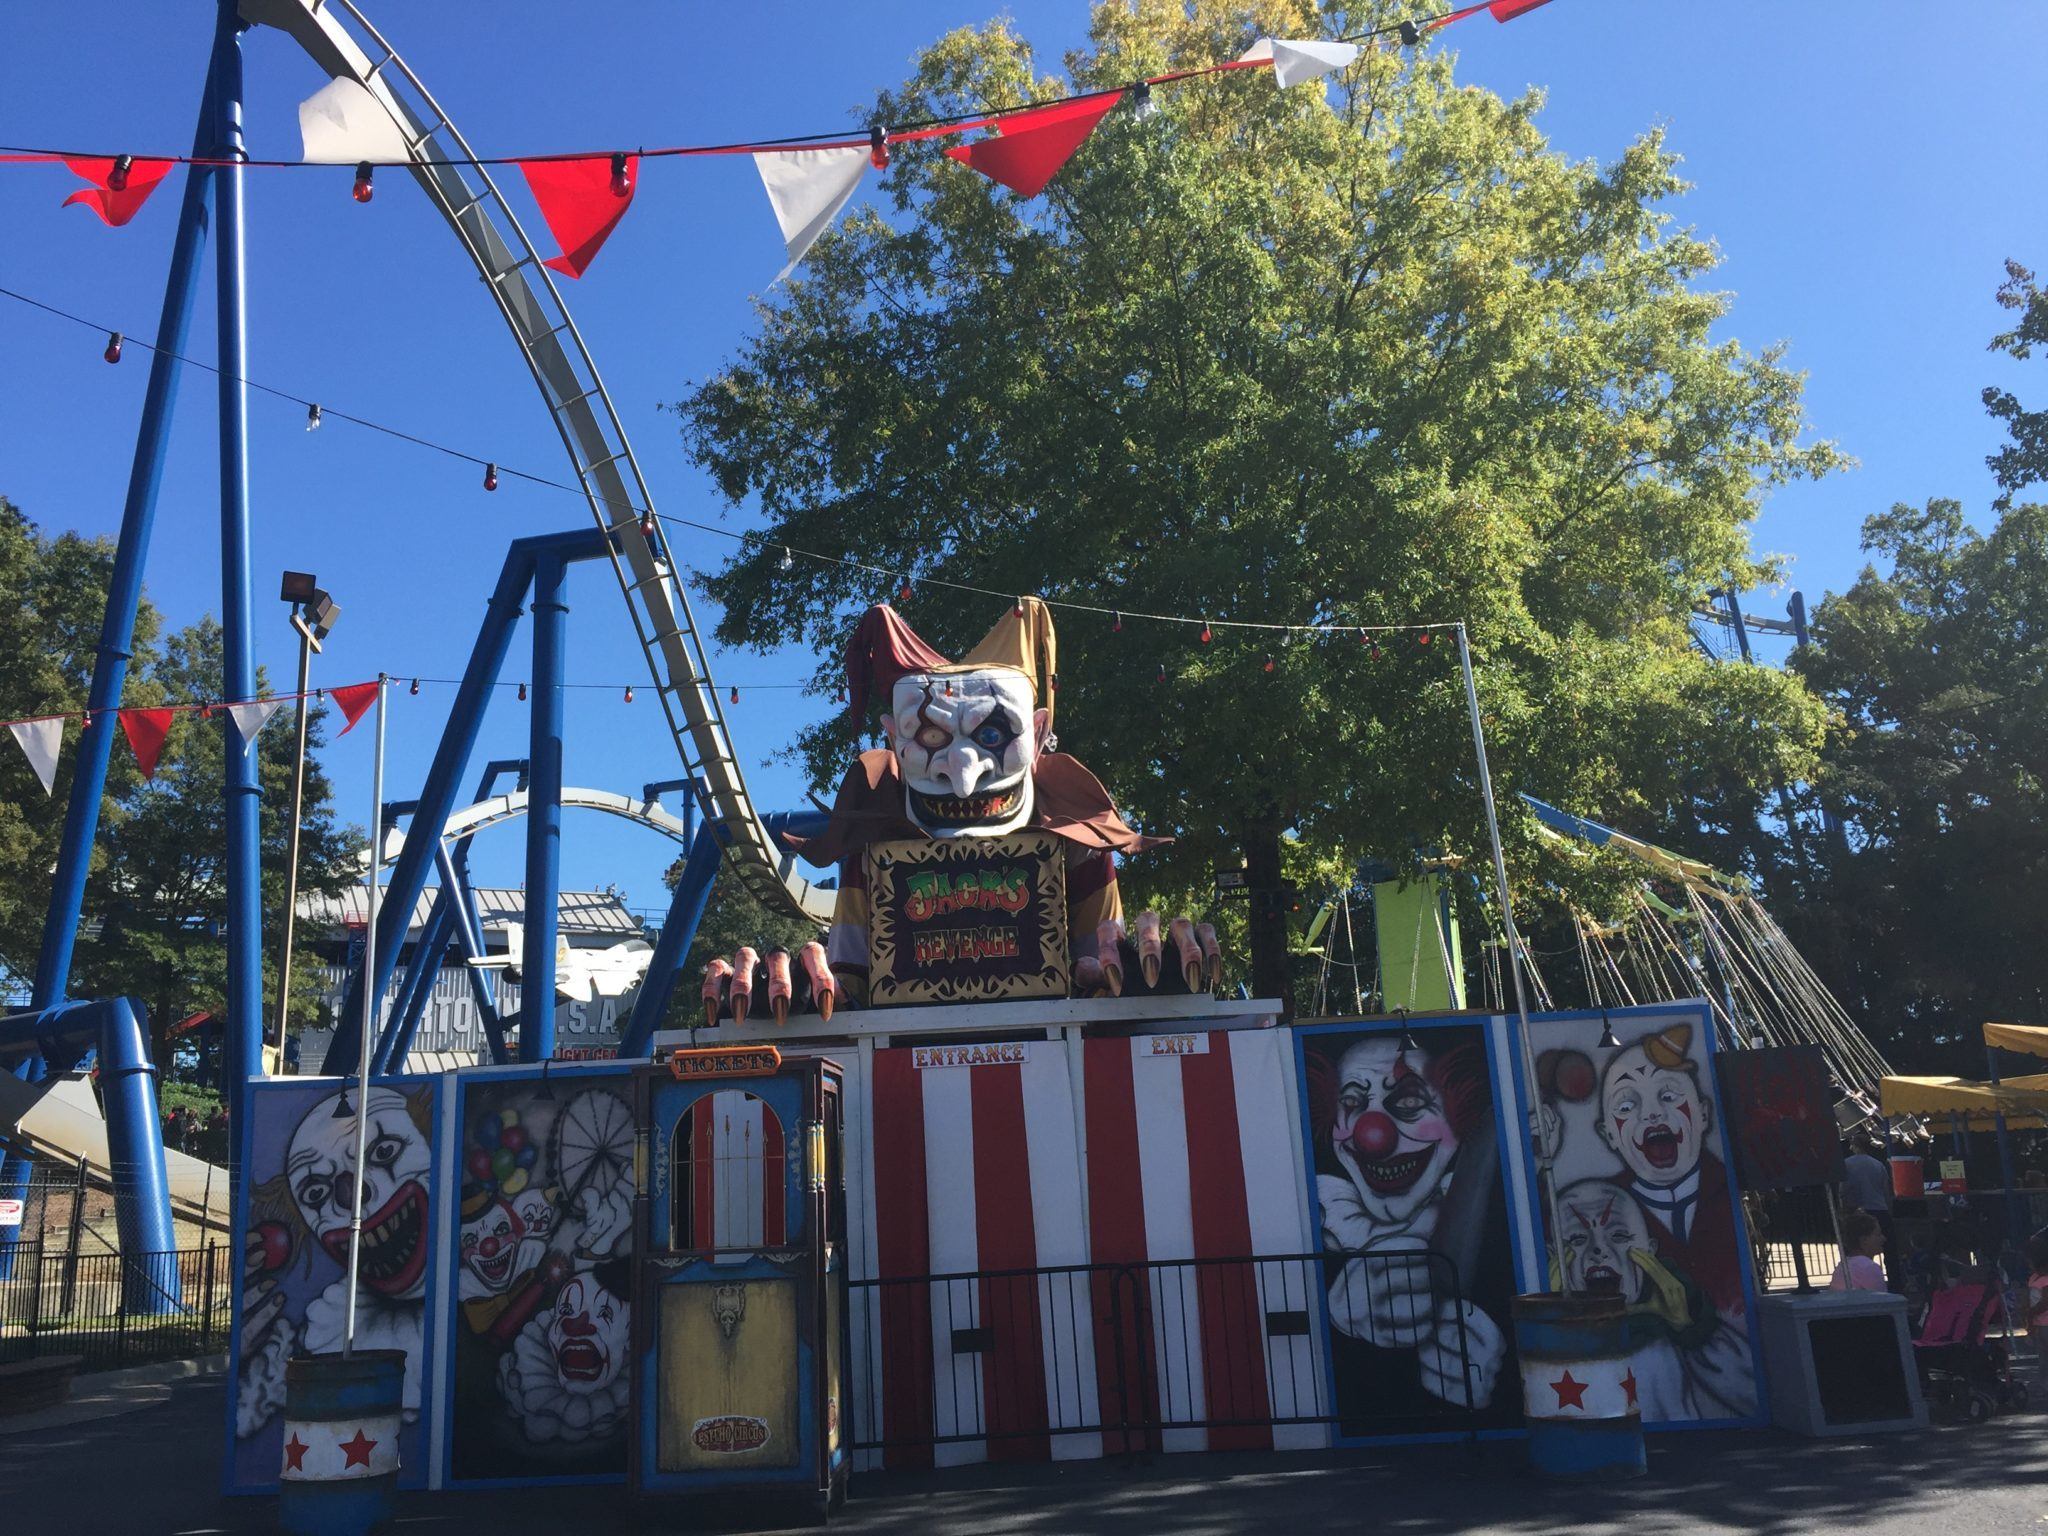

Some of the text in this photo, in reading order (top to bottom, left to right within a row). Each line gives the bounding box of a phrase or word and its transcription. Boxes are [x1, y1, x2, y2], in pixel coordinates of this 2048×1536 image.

[904, 866, 1029, 922] JACK'S
[913, 926, 1019, 964] REVENGE
[916, 1044, 1024, 1067] ENTRANCE
[1152, 1036, 1196, 1055] EXIT
[675, 1054, 776, 1073] TICKETS
[699, 1425, 764, 1443] PSYCHO CIRCUS
